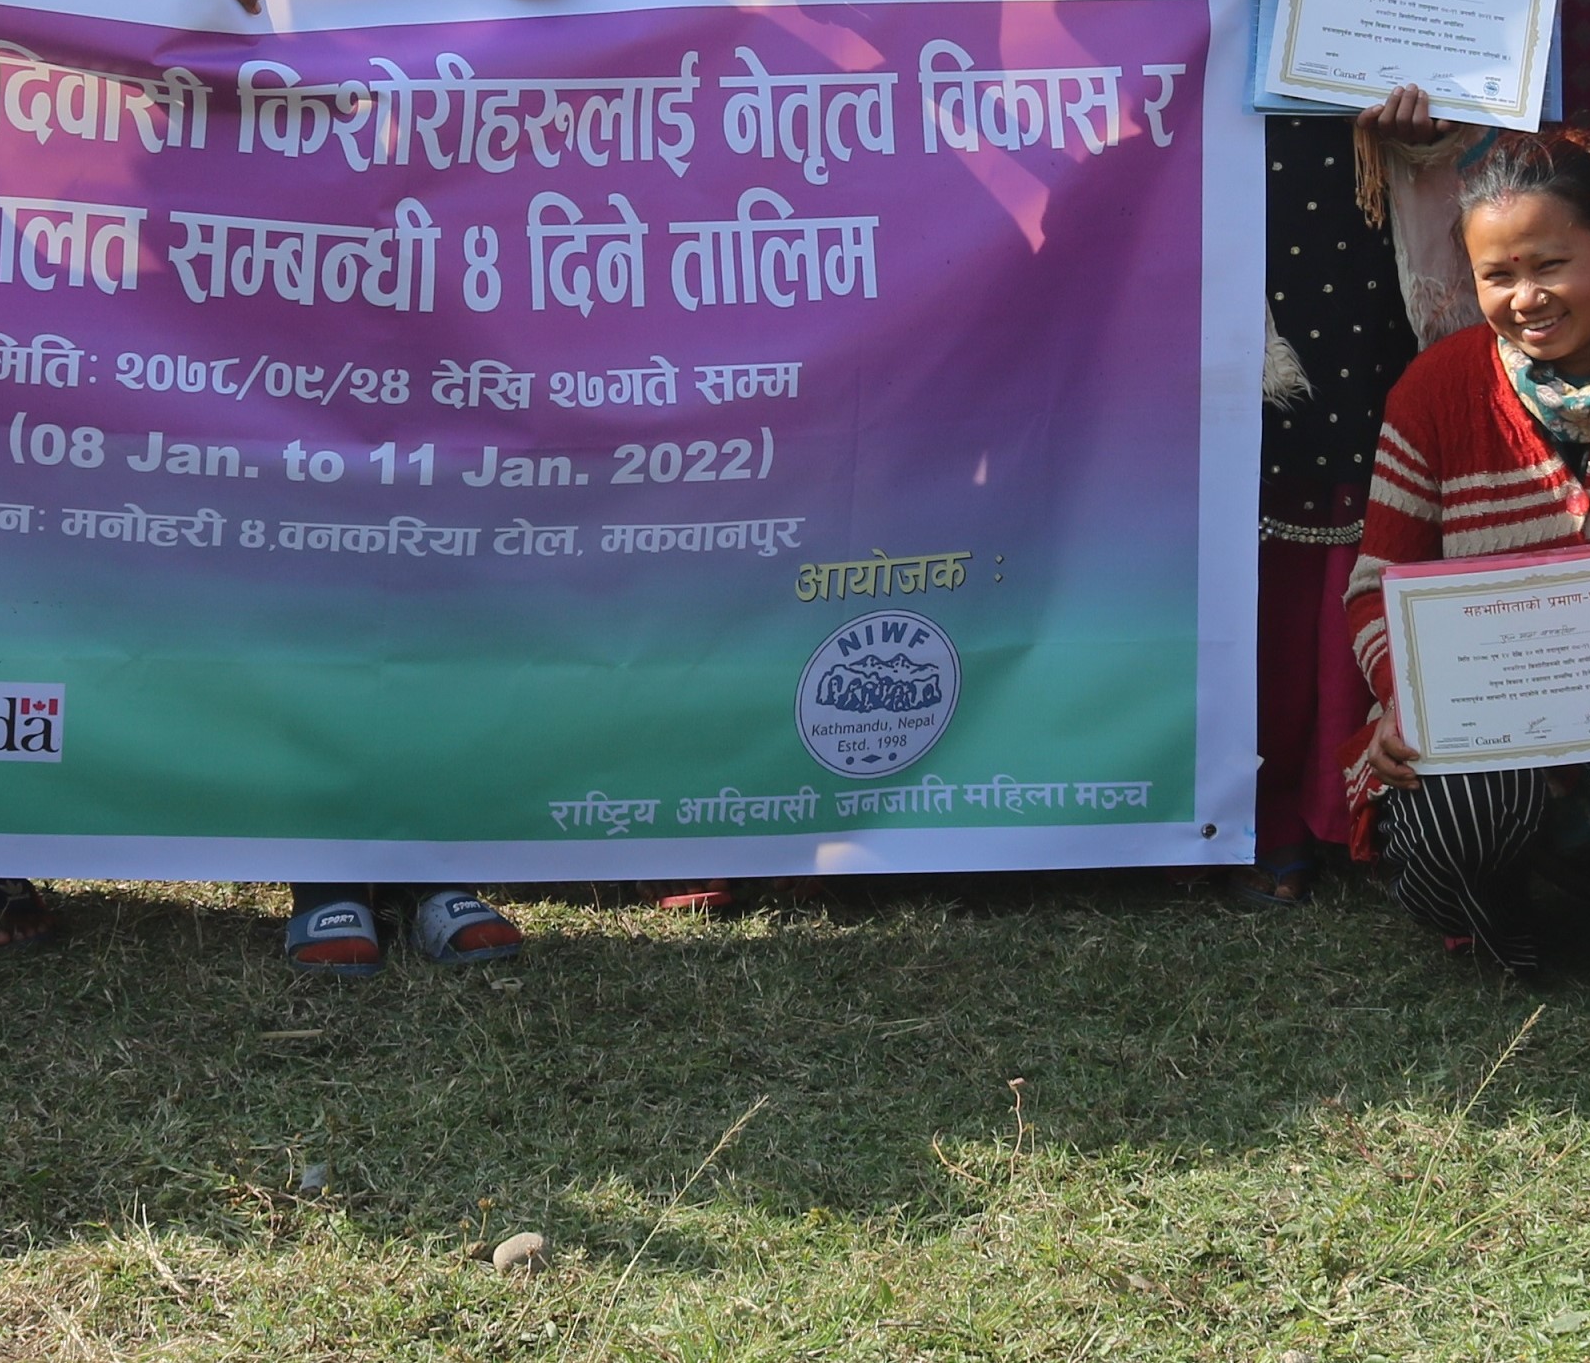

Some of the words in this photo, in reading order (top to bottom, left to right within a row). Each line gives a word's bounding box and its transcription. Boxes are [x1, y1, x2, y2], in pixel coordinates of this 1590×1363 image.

[237, 50, 700, 179] किशोरीहरुलाई
[719, 45, 898, 185] नेतृत्व
[919, 38, 1122, 157] विकास
[1142, 63, 1186, 149] र
[167, 193, 441, 314] सम्बन्धी
[462, 225, 500, 315] ४
[527, 191, 648, 319] दिने
[669, 185, 879, 312] तालिम
[116, 350, 410, 406] २०७८/०९/२४
[431, 358, 534, 411] देखि
[550, 355, 679, 408] २७गते
[694, 361, 802, 403] सम्म
[9, 410, 106, 470] (08
[126, 430, 258, 480] Jan.
[282, 439, 345, 484] to
[369, 442, 435, 487] 11
[462, 445, 589, 489] Jan.
[610, 426, 775, 486] 2022)
[62, 503, 226, 549] मनोहरी
[493, 517, 583, 558] टोल,
[601, 515, 806, 557] मकवानपुर
[793, 547, 971, 603] आयोजक
[1463, 596, 1540, 618] सहभागिताको
[837, 621, 930, 657] NIWF
[812, 718, 893, 737] Kathmandu,
[898, 714, 935, 731] Nepal
[837, 739, 870, 753] Estd.
[877, 734, 907, 749] 1998
[548, 795, 660, 836] राष्ट्रिय
[676, 785, 819, 828] आदिवासी
[836, 776, 957, 819] जनजाति
[962, 774, 1068, 814] महिला
[1074, 780, 1152, 810] मञ्च
[320, 914, 355, 928] SPORT
